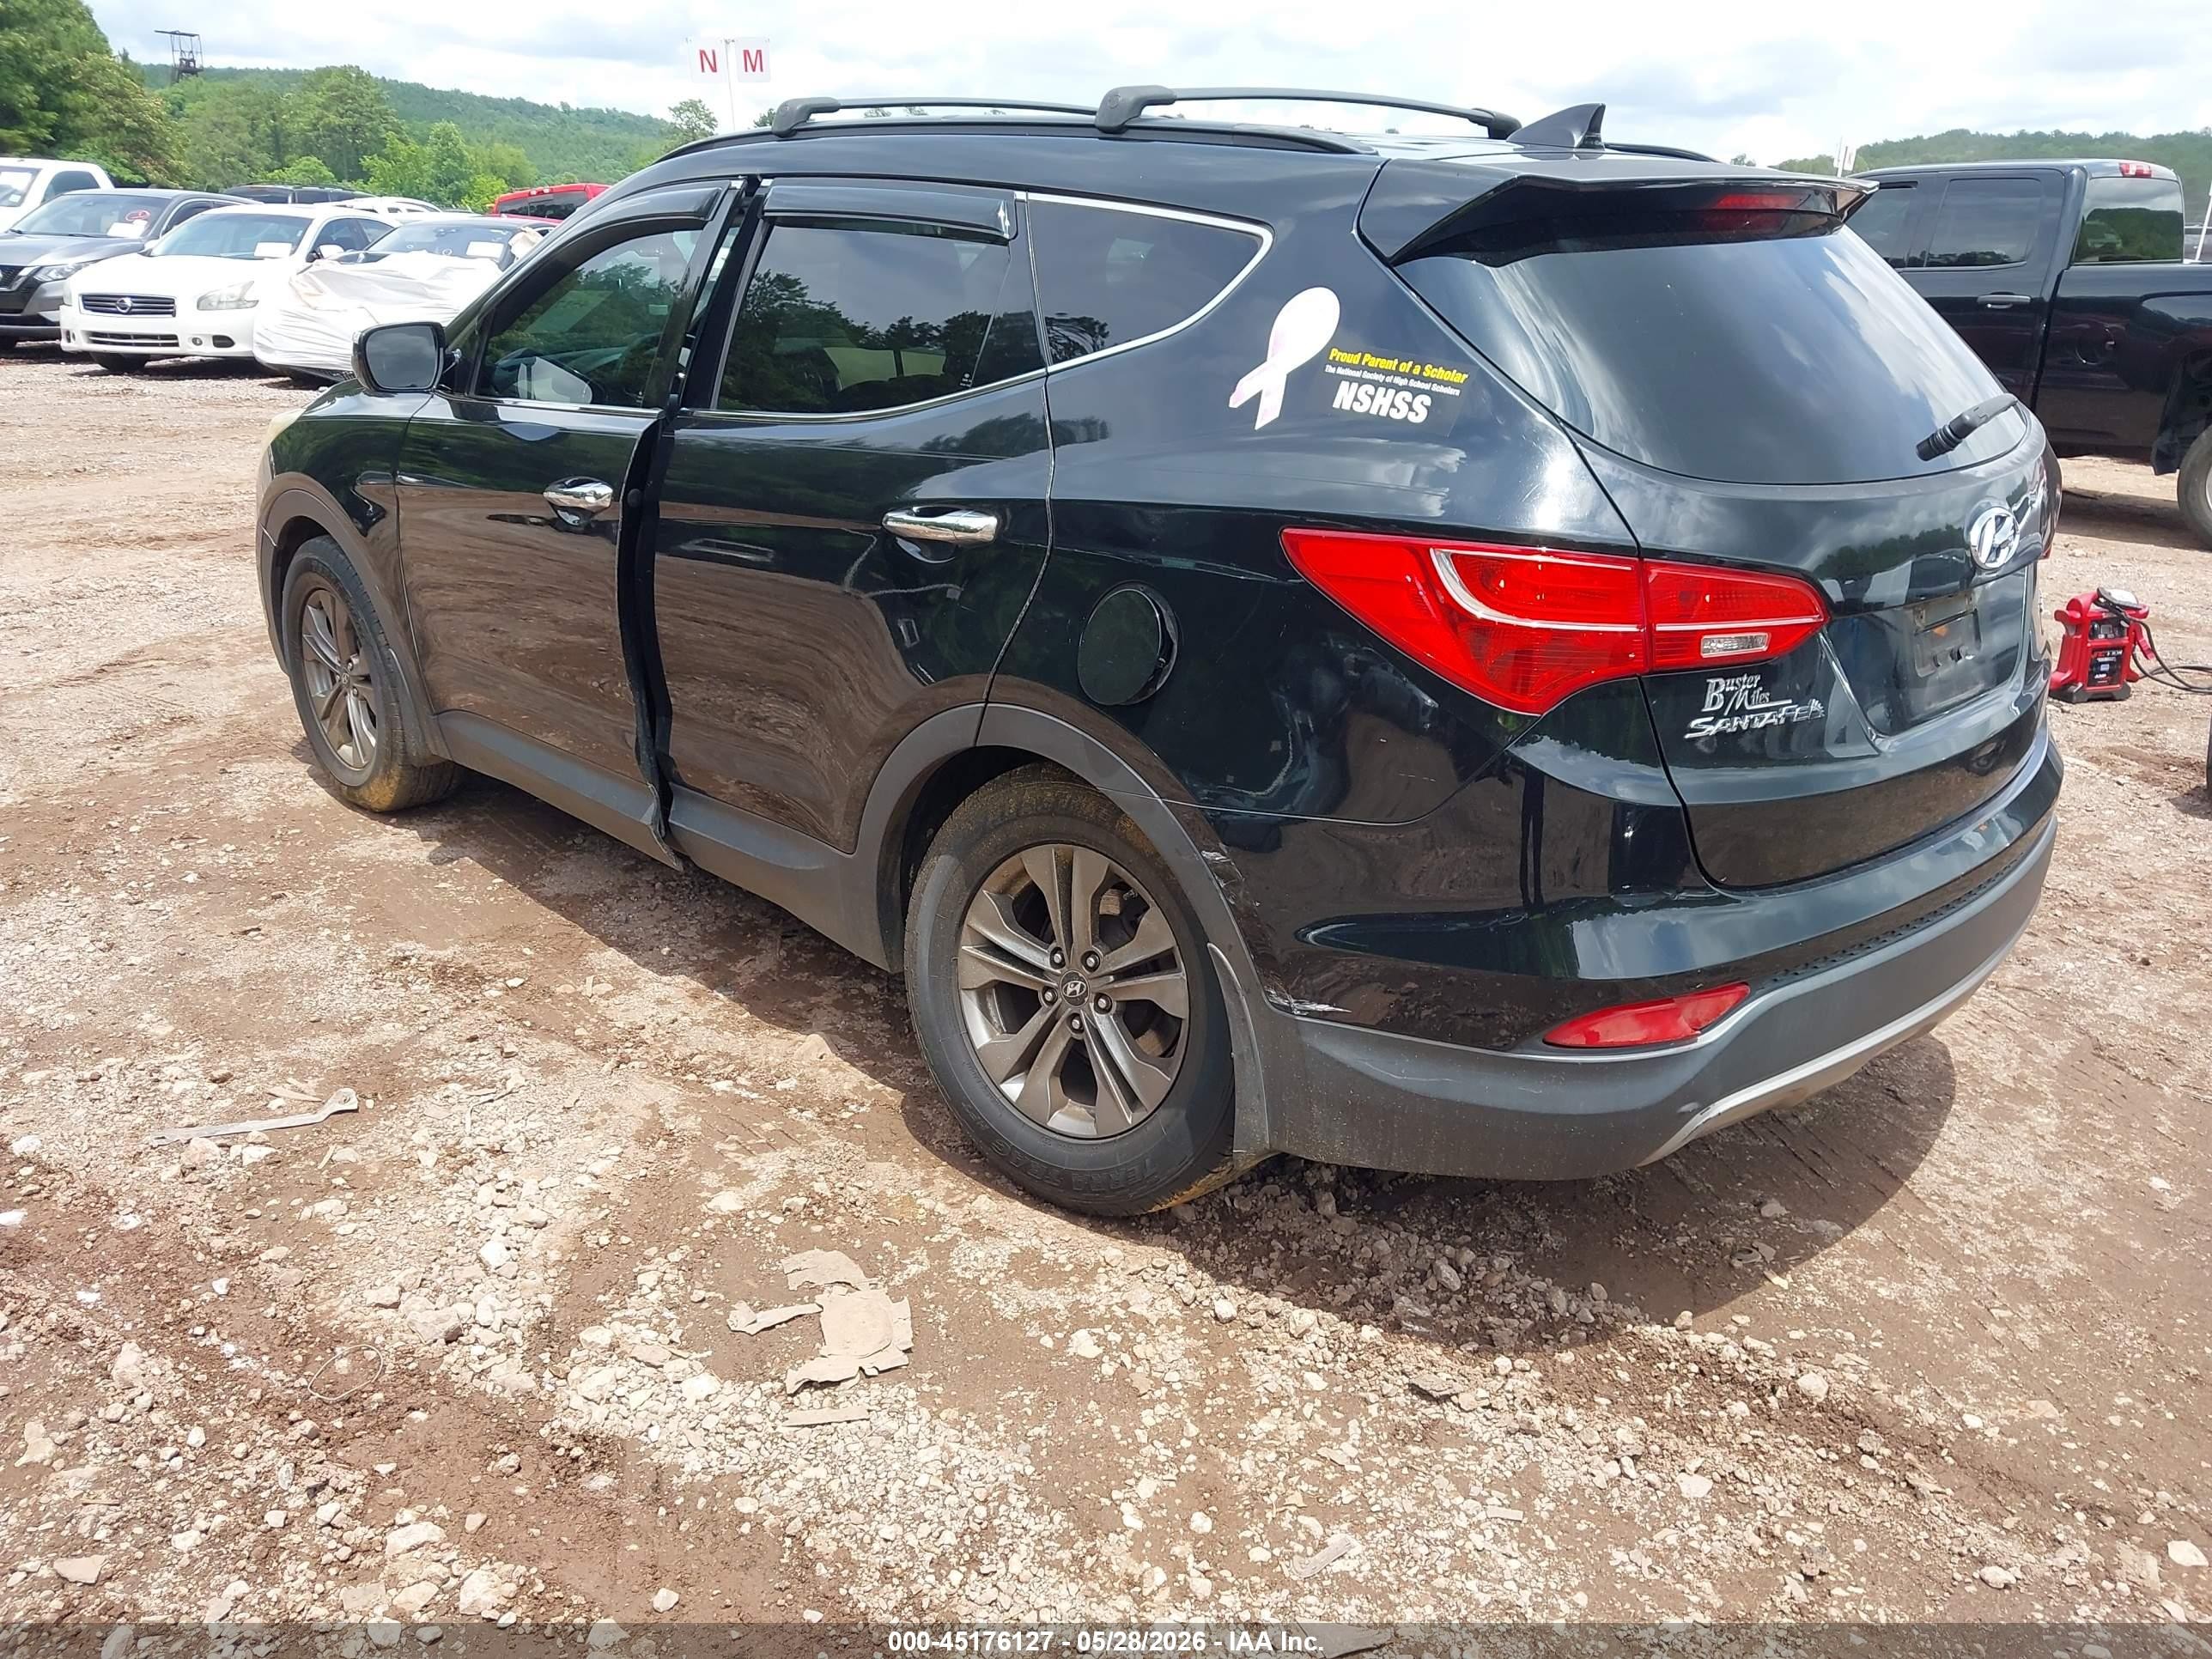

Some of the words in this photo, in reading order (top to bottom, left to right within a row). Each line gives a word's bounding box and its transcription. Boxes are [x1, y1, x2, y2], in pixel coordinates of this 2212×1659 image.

[699, 49, 718, 73] N
[743, 49, 763, 73] M
[1325, 364, 1337, 374] The
[1336, 366, 1363, 378] National
[1362, 369, 1385, 383] Society
[1393, 375, 1409, 386] High
[1408, 379, 1432, 390] School
[1328, 348, 1362, 365] Proud
[1362, 353, 1399, 371] Parent
[1399, 360, 1413, 374] of
[1413, 364, 1422, 375] a
[1423, 363, 1469, 384] Scholar
[1333, 380, 1432, 423] NSHSS
[1701, 673, 1761, 712] Buster
[1724, 687, 1792, 716] Miles
